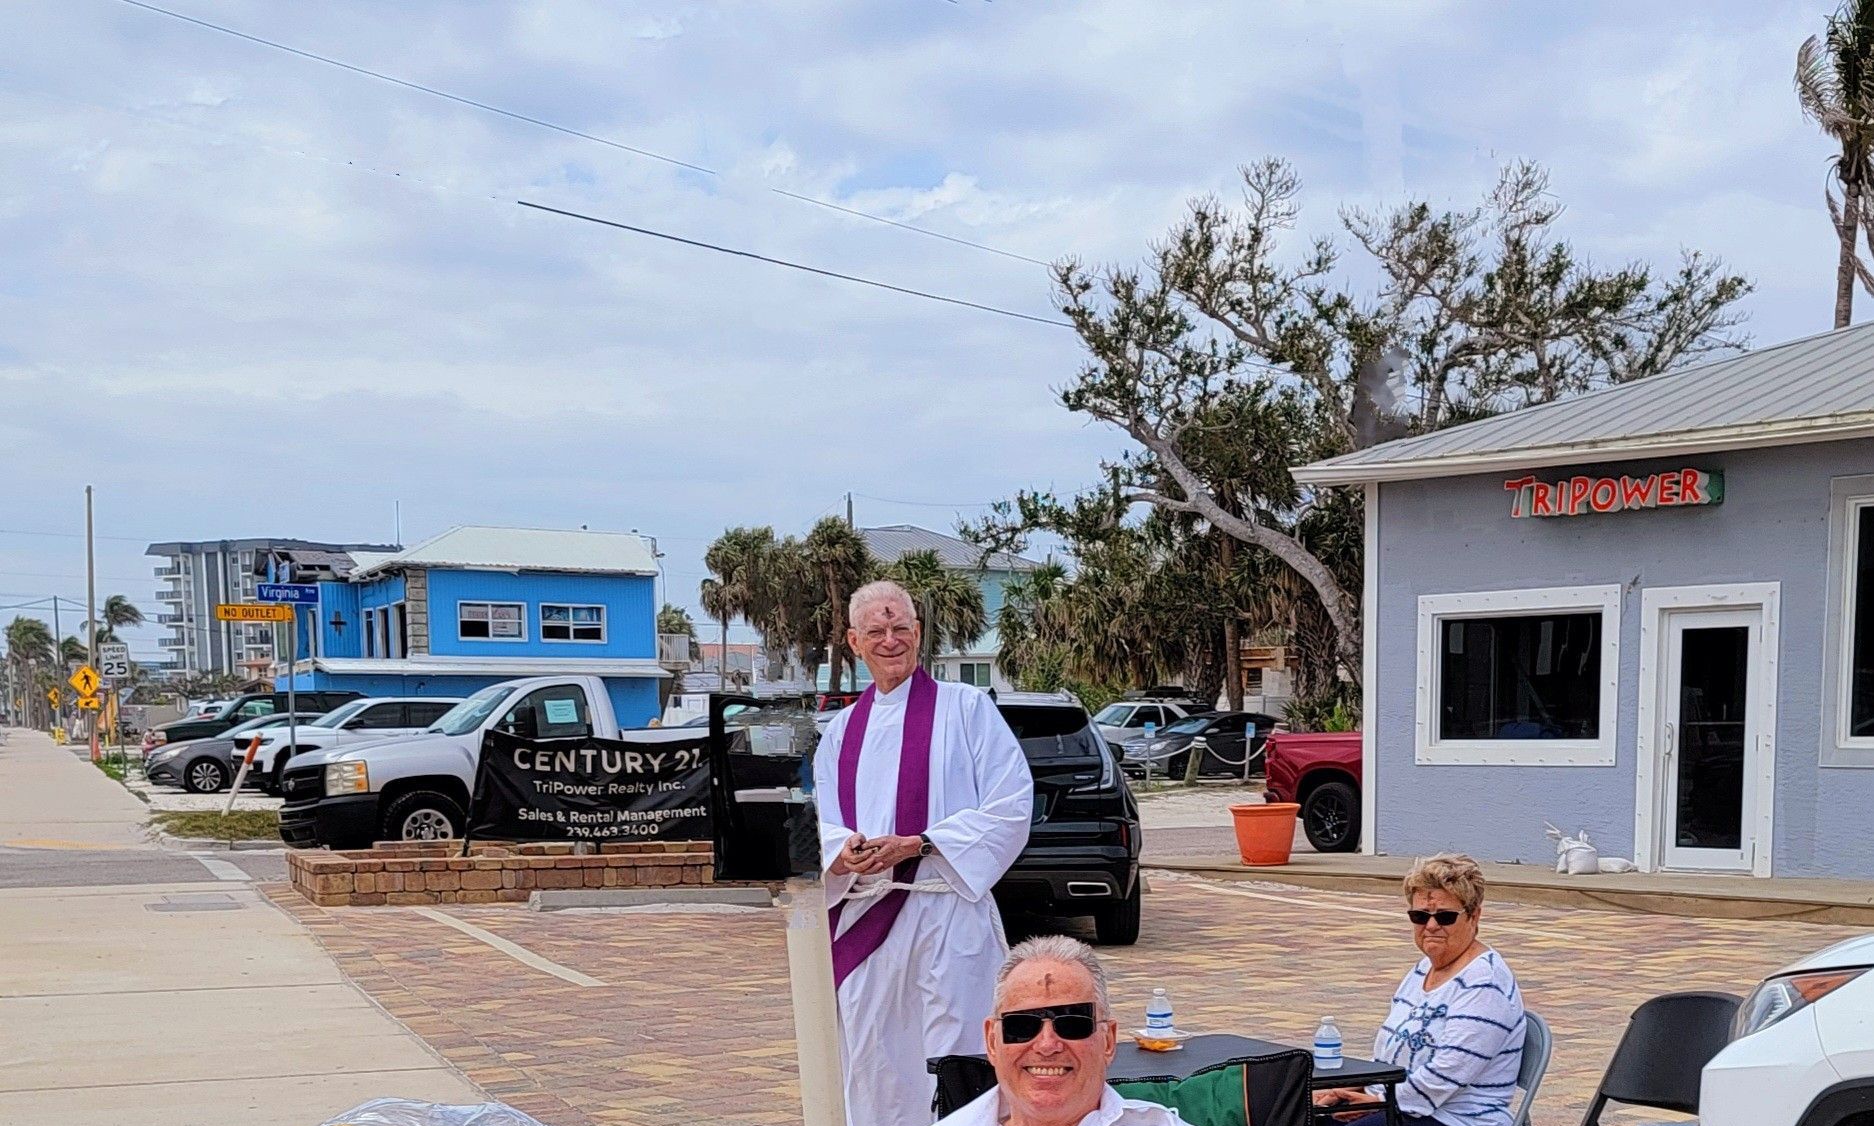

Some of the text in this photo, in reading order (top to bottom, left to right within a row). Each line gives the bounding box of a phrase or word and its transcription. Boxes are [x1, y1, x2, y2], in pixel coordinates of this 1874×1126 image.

[1504, 468, 1702, 518] TRIPOWER
[261, 586, 300, 600] Virginia
[223, 608, 276, 618] NO OUTLET
[104, 662, 127, 675] 25
[513, 748, 667, 774] CENTURY
[533, 779, 686, 796] TriPower Realty Inc.
[518, 805, 707, 823] Sales & Rental Management
